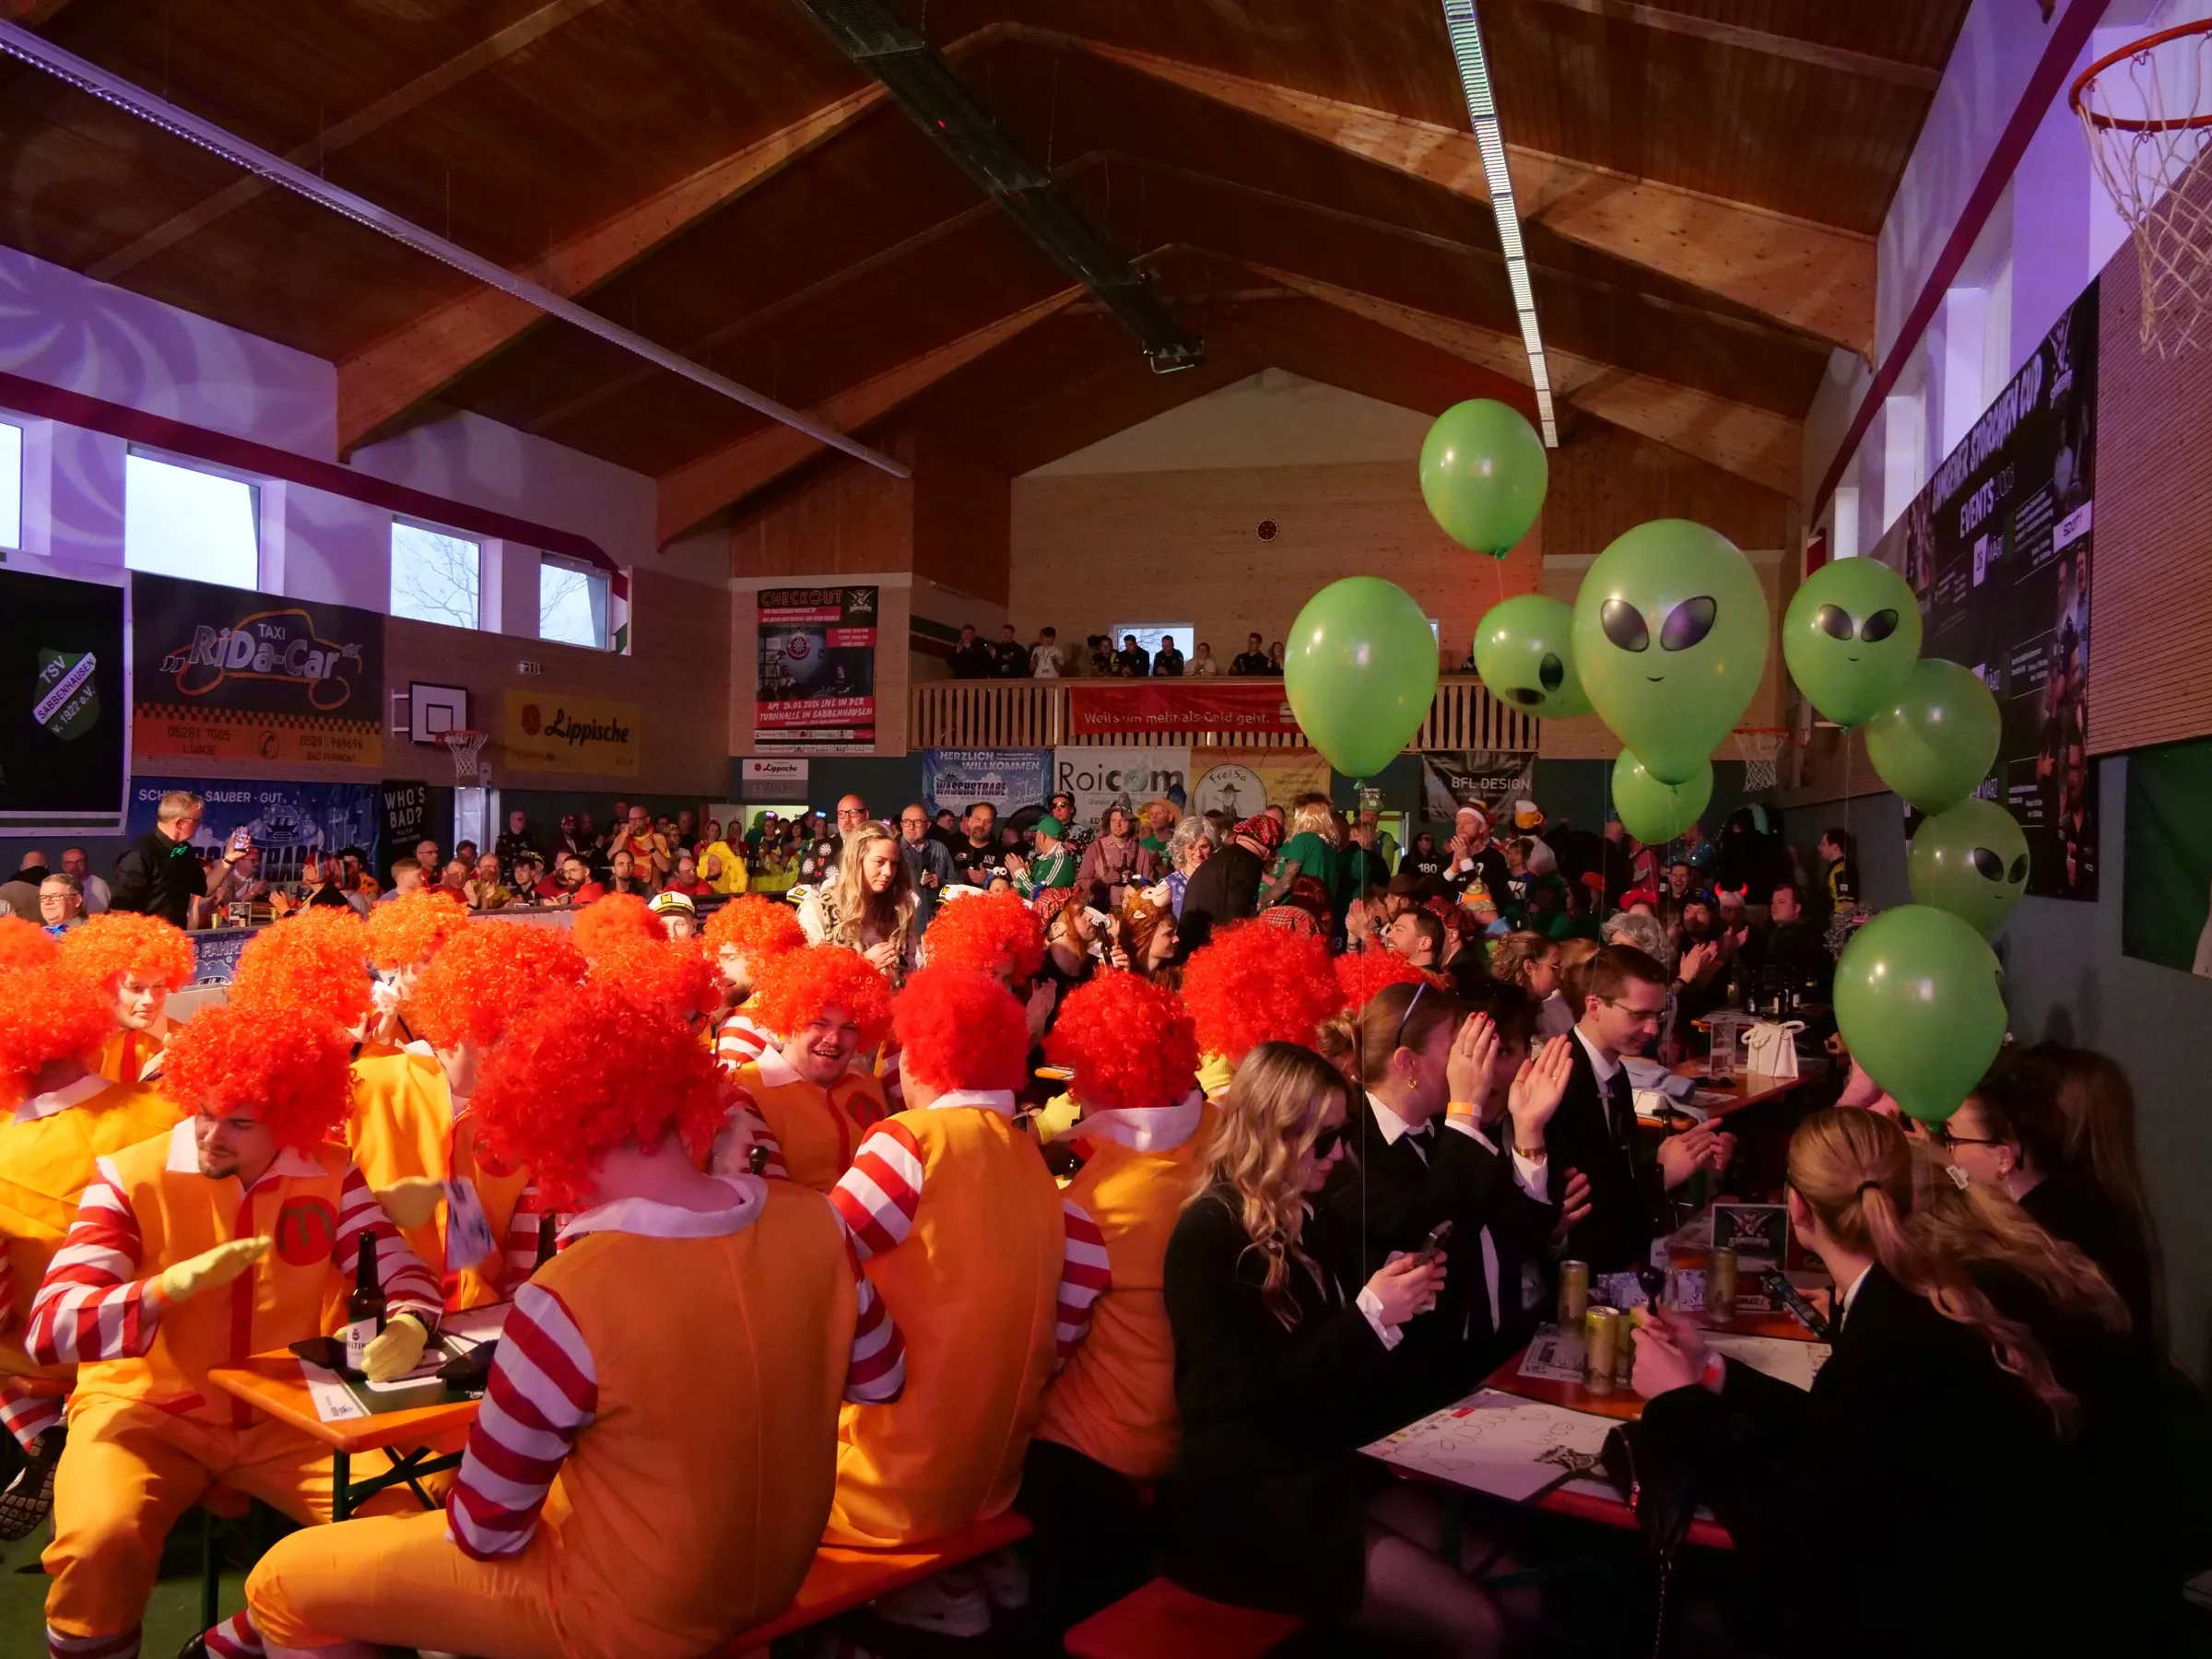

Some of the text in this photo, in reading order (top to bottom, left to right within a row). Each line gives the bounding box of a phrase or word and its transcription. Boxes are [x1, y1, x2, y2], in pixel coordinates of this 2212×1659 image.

[1960, 477, 1994, 539] EVENTS
[760, 590, 843, 606] CHECKOUT
[257, 623, 286, 641] TAXI
[40, 655, 65, 684] TSV
[37, 657, 95, 720] SABBENHAUSEN
[60, 700, 81, 724] 1922
[79, 685, 96, 705] e.V.
[767, 702, 780, 711] AM
[820, 699, 837, 708] LIVE
[838, 698, 847, 706] IN
[849, 697, 865, 706] DER
[759, 707, 873, 722] TURNHALLE IN SABBENHAUSEN
[1146, 712, 1179, 724] mehr
[1182, 711, 1200, 724] als
[1204, 711, 1232, 724] Geld
[1236, 712, 1270, 726] geht.
[168, 725, 201, 738] 05281
[545, 708, 629, 747] Lippische
[940, 751, 994, 760] HERZLICH
[762, 763, 798, 773] Lippische
[962, 761, 1041, 771] WILLKOMMEN
[1060, 761, 1184, 792] Roicom
[1208, 769, 1247, 783] FreiSa
[1452, 777, 1477, 789] BFL
[205, 790, 252, 803] SAUBER
[383, 786, 426, 810] WHO'S
[390, 806, 424, 829] BAD?
[1418, 863, 1438, 874] 180
